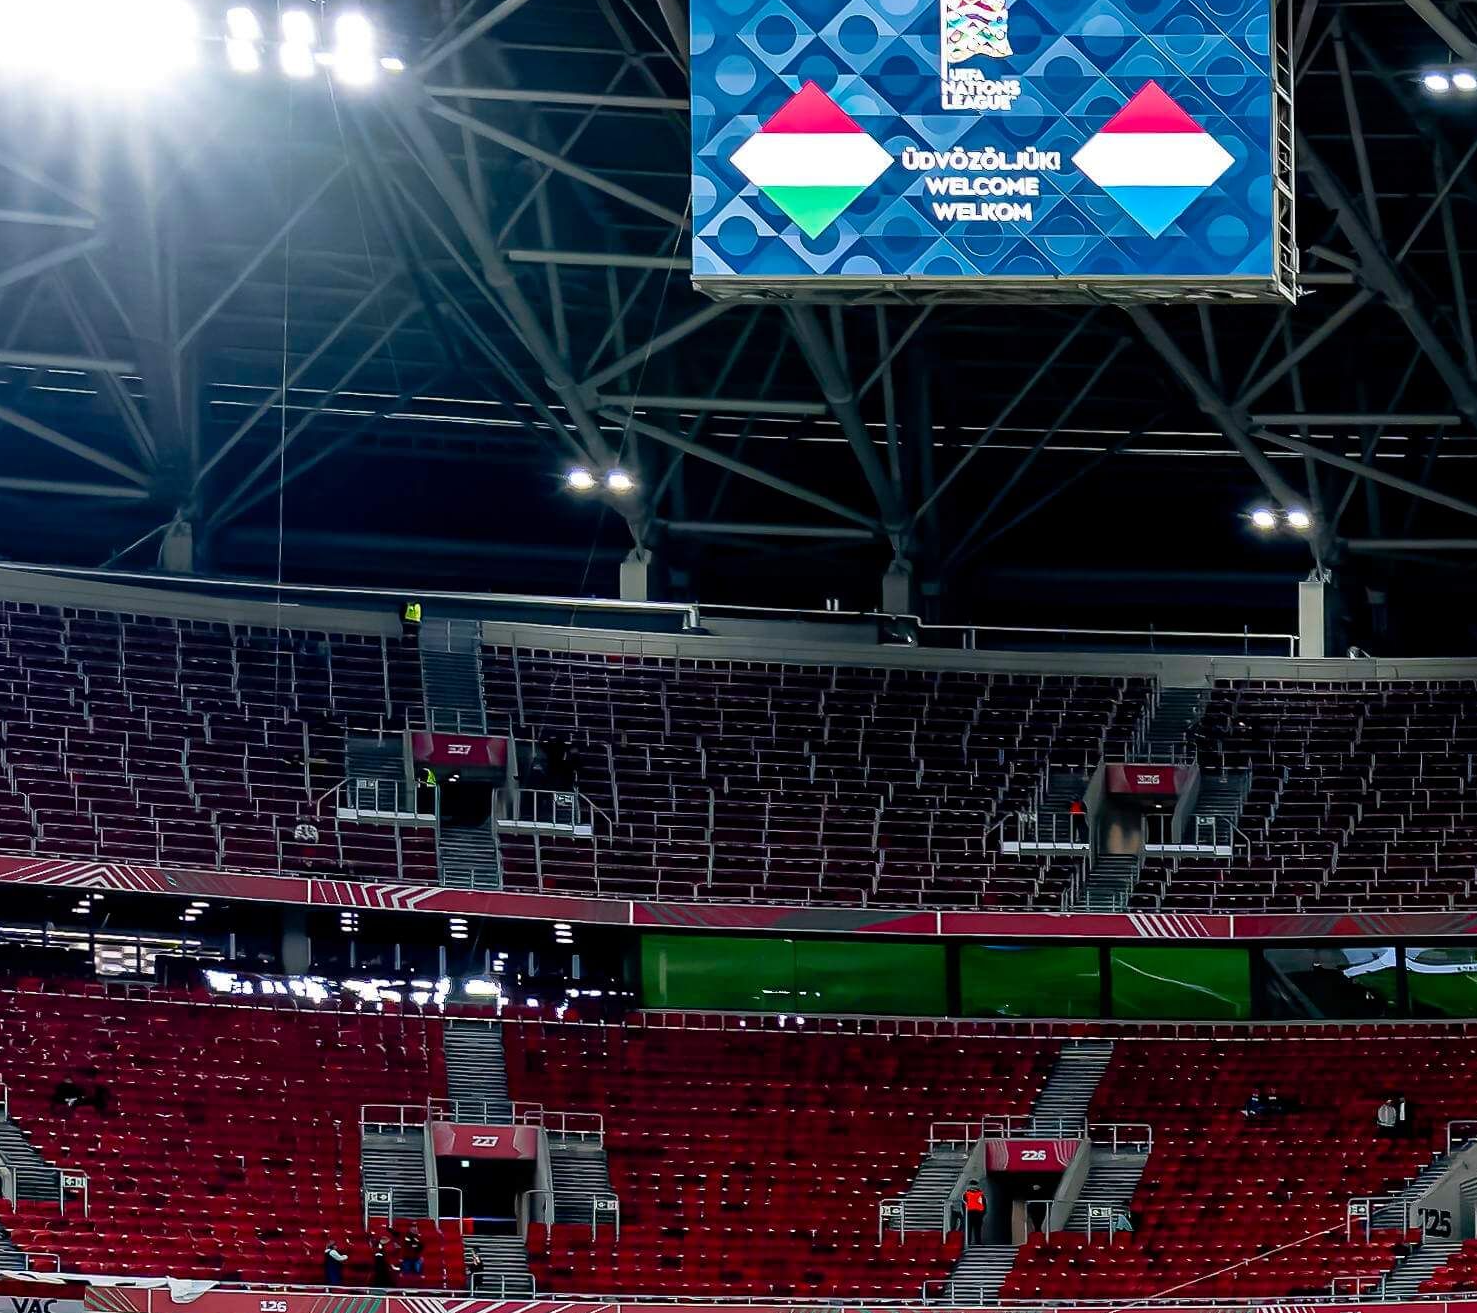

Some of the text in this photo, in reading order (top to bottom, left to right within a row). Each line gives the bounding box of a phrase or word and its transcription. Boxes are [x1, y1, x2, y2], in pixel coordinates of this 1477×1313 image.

[941, 80, 1021, 96] NATIONS
[941, 95, 1012, 110] LEAGUE
[925, 177, 1040, 196] WELCOME
[932, 202, 1033, 221] WELKOM
[472, 1136, 498, 1146] 227
[260, 1300, 287, 1313] 126
